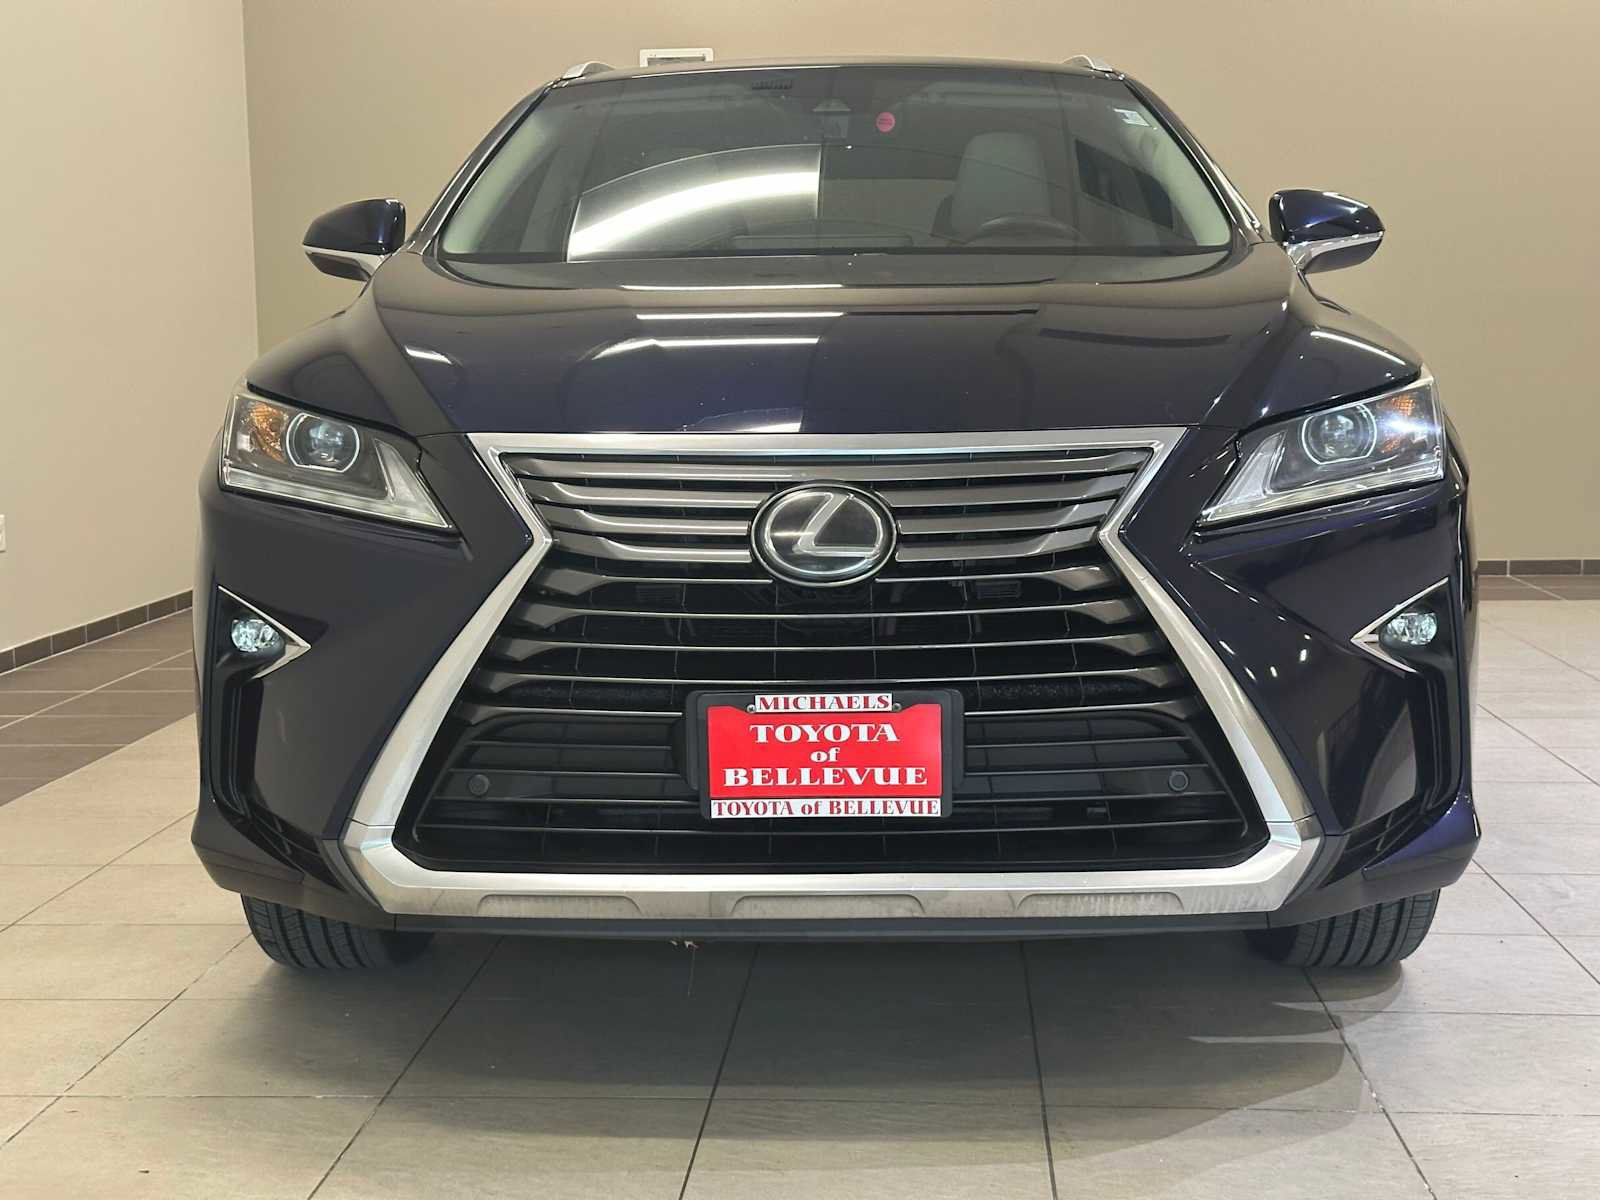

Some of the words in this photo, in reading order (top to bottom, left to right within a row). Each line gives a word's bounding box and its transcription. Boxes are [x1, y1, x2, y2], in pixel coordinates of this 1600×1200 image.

[759, 695, 889, 711] MICHAELS
[749, 723, 899, 743] TOYOTA
[810, 747, 840, 762] of
[723, 767, 927, 787] BELLEVUE
[713, 801, 794, 816] TOYOTA
[800, 801, 822, 815] of
[829, 800, 939, 815] BELLEVUE
